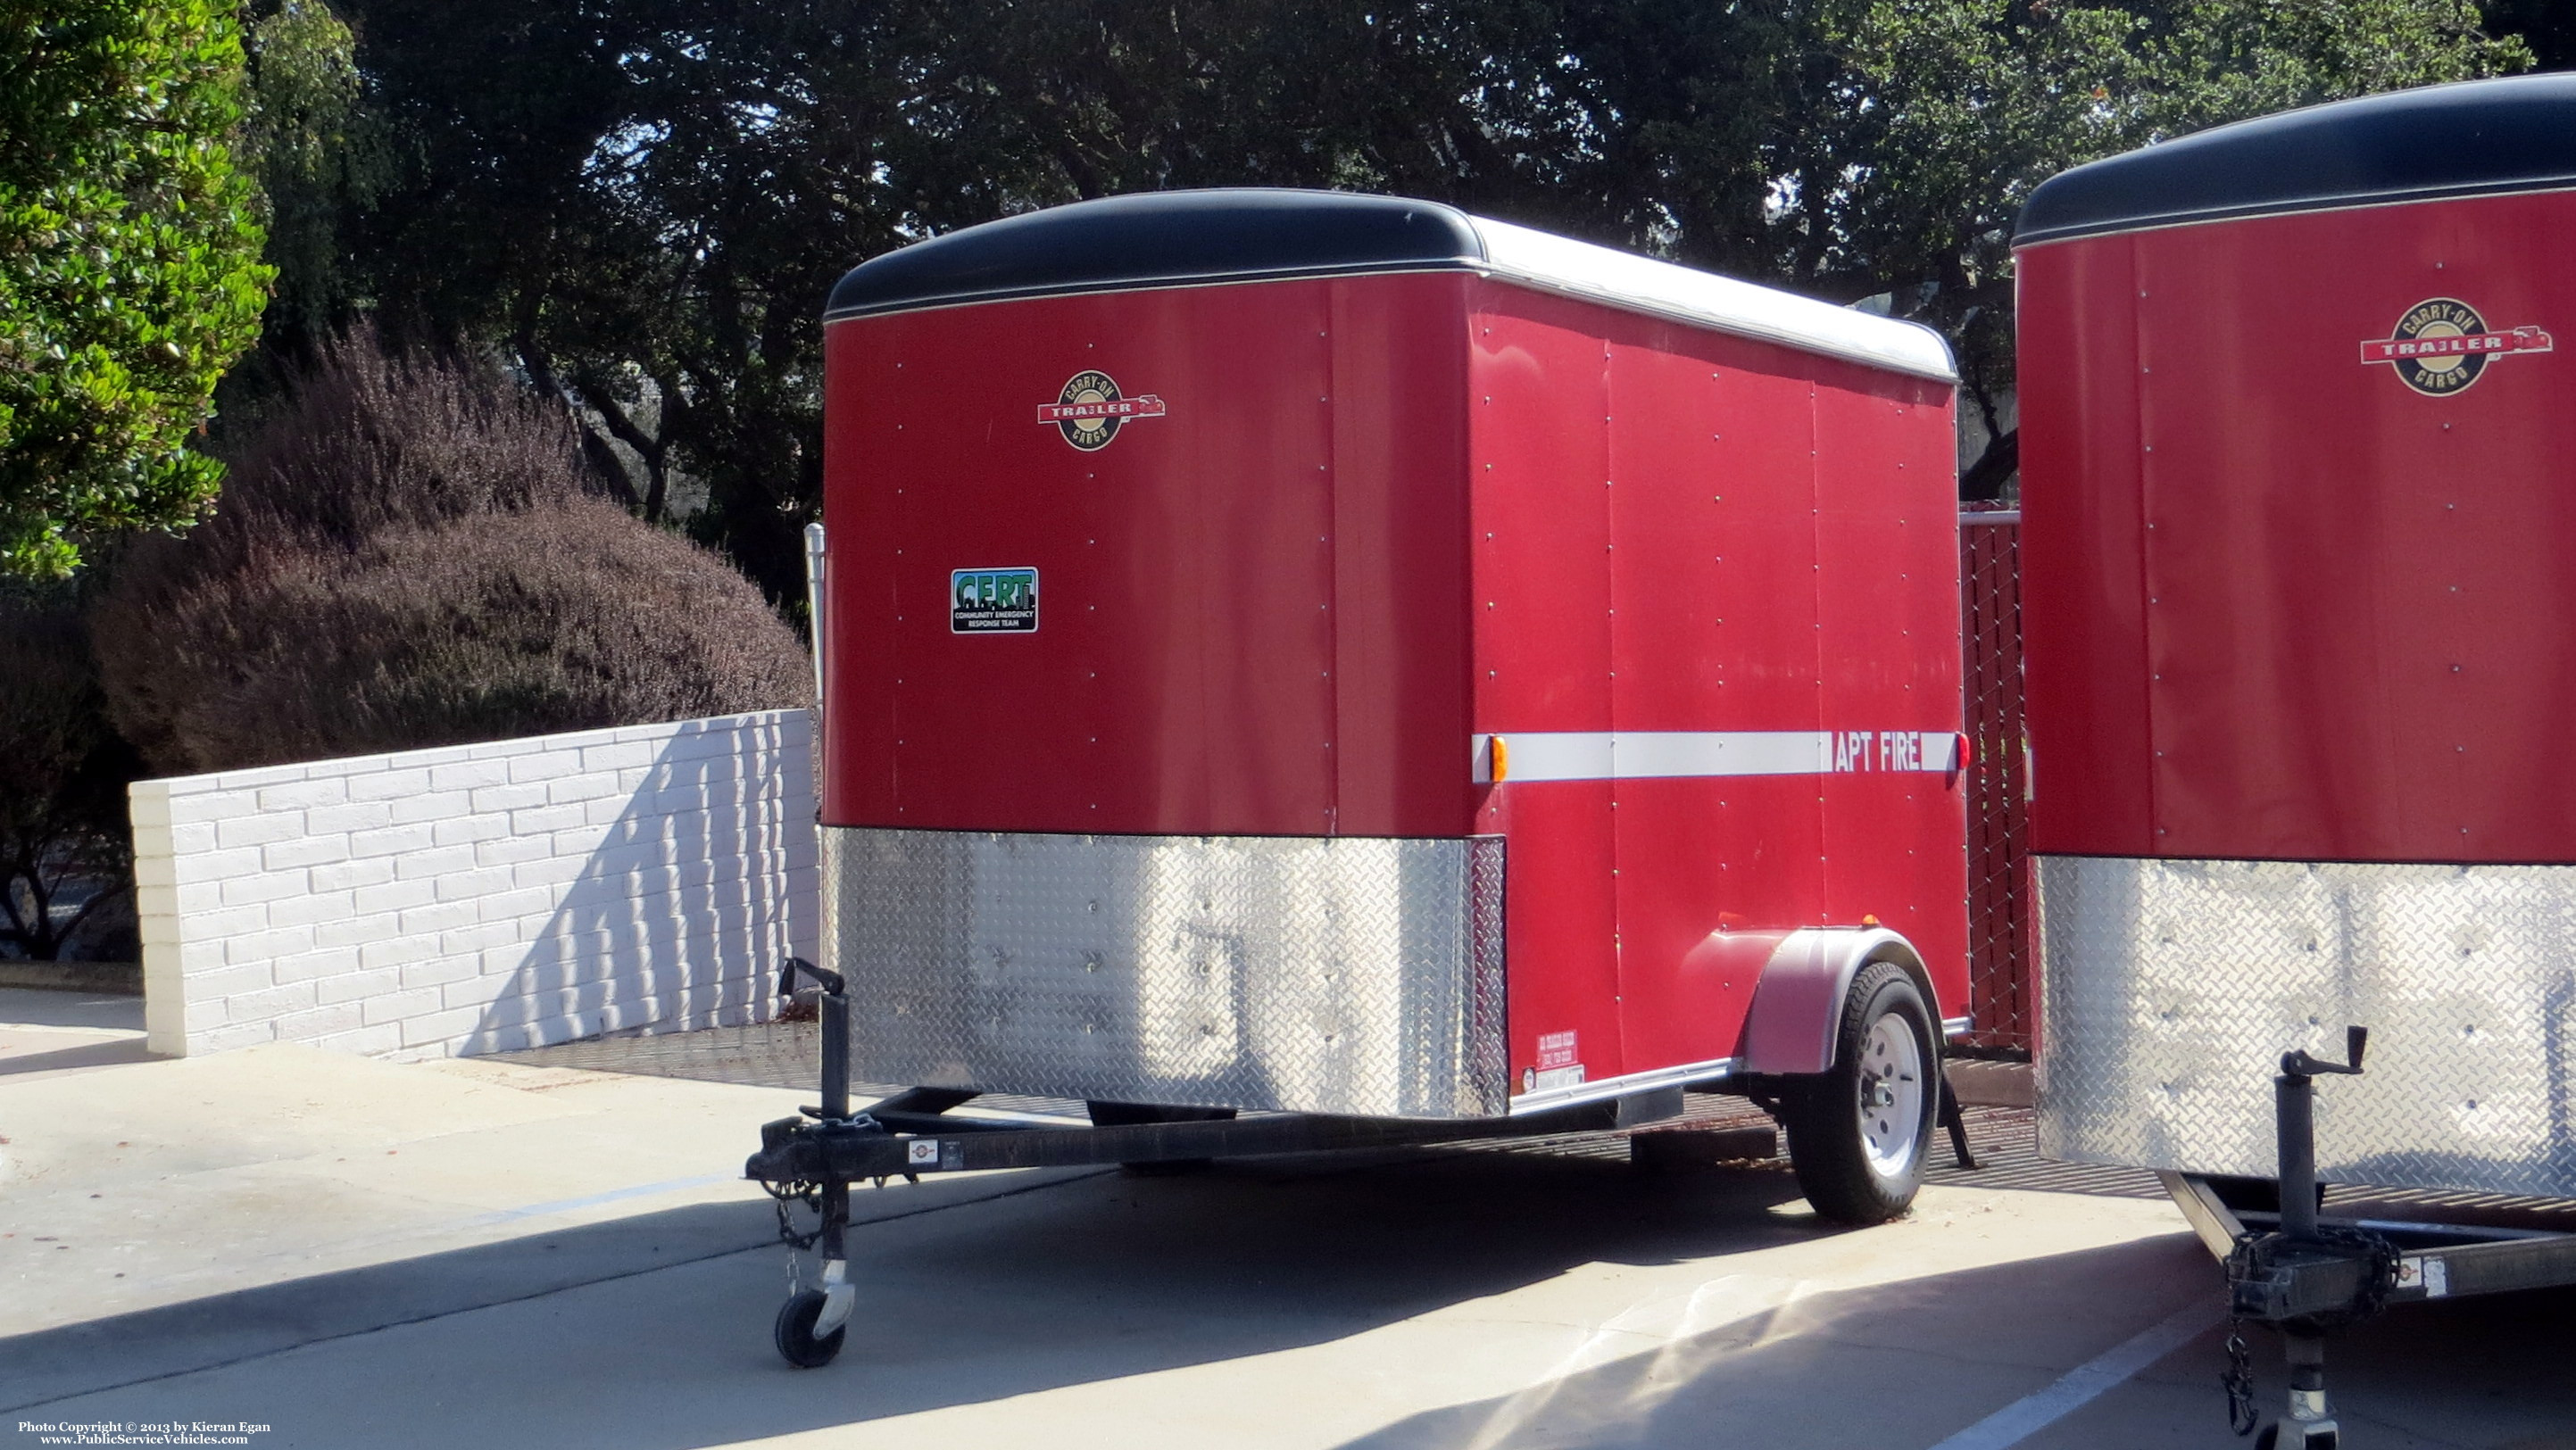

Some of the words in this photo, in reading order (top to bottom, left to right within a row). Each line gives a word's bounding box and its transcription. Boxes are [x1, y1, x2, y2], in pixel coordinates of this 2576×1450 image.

[2403, 304, 2476, 335] CARRY-ON
[2381, 337, 2502, 356] TRAILER
[2414, 367, 2468, 388] CARGO
[1066, 376, 1114, 400] CARRY-ON
[1051, 403, 1132, 417] TRAILER
[1072, 427, 1108, 444] CARGO
[957, 574, 1033, 609] CERT
[955, 611, 993, 619] COMMUNITY
[995, 610, 1034, 618] EMERGENCY
[968, 619, 1000, 627] RESPONSE
[1835, 732, 1872, 772] APT
[1880, 732, 1920, 771] FIRE
